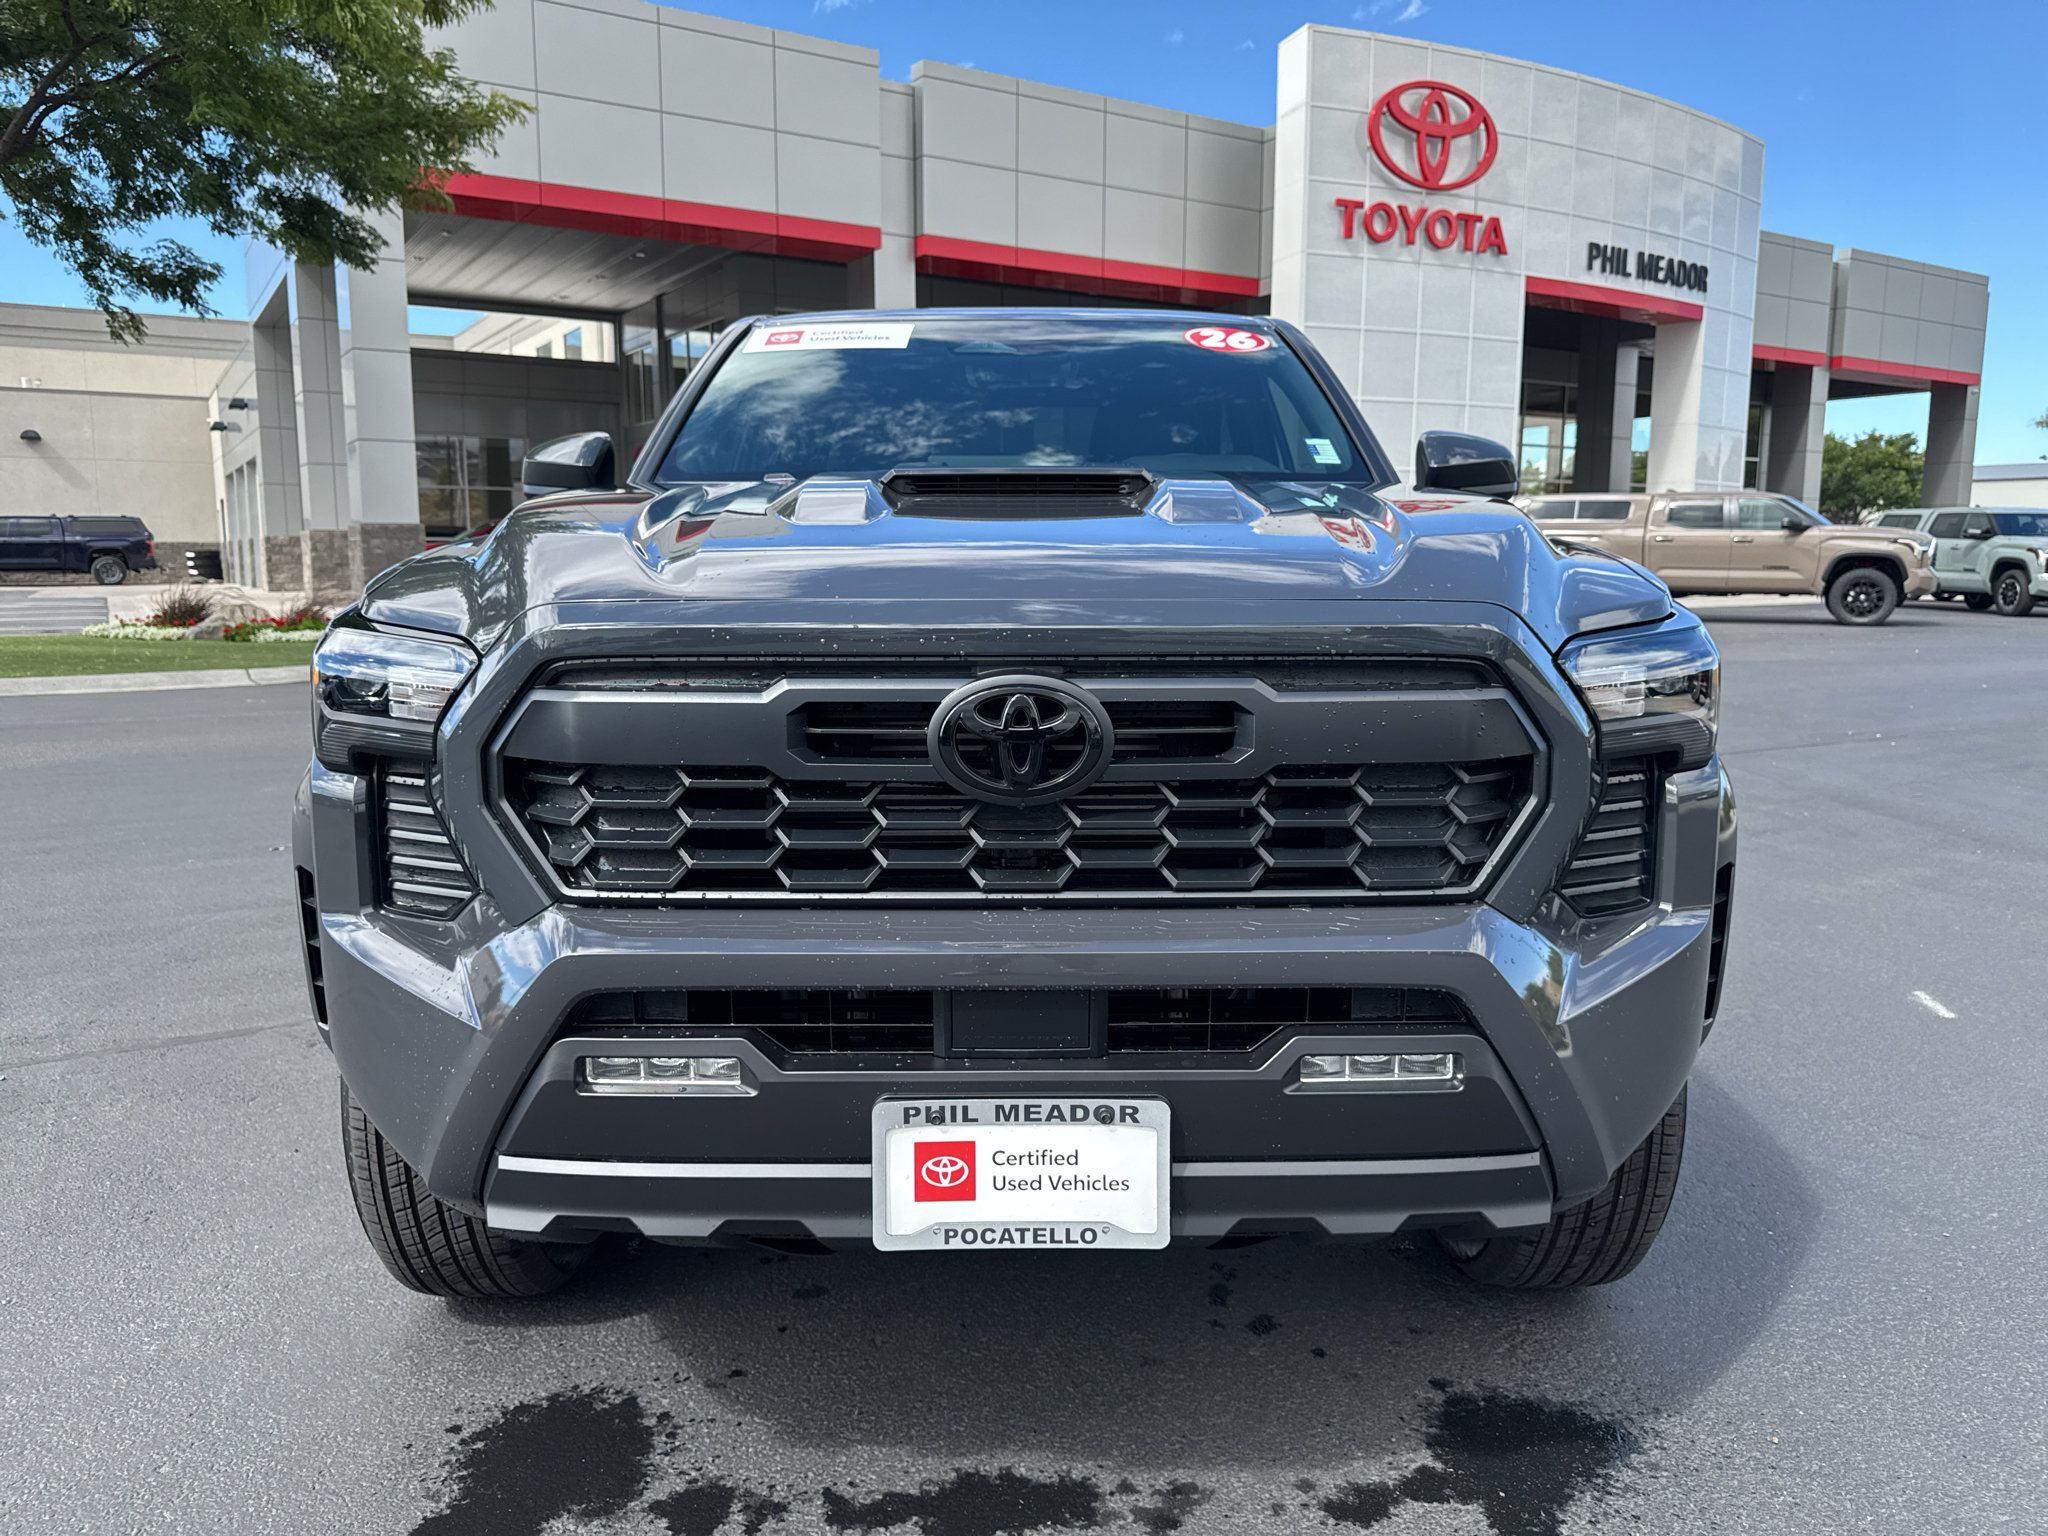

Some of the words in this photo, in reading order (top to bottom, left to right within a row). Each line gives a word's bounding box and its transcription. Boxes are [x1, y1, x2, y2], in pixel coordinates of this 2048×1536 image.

[1334, 198, 1507, 255] TOYOTA
[1587, 242, 1632, 277] PHIL
[1636, 252, 1708, 293] MEADOR
[1199, 329, 1258, 349] 26
[994, 1104, 1140, 1124] MEADOR
[992, 1149, 1079, 1166] Certified
[992, 1174, 1042, 1191] Used
[1049, 1174, 1130, 1191] Vehicles
[944, 1228, 1098, 1245] POCATELLO
